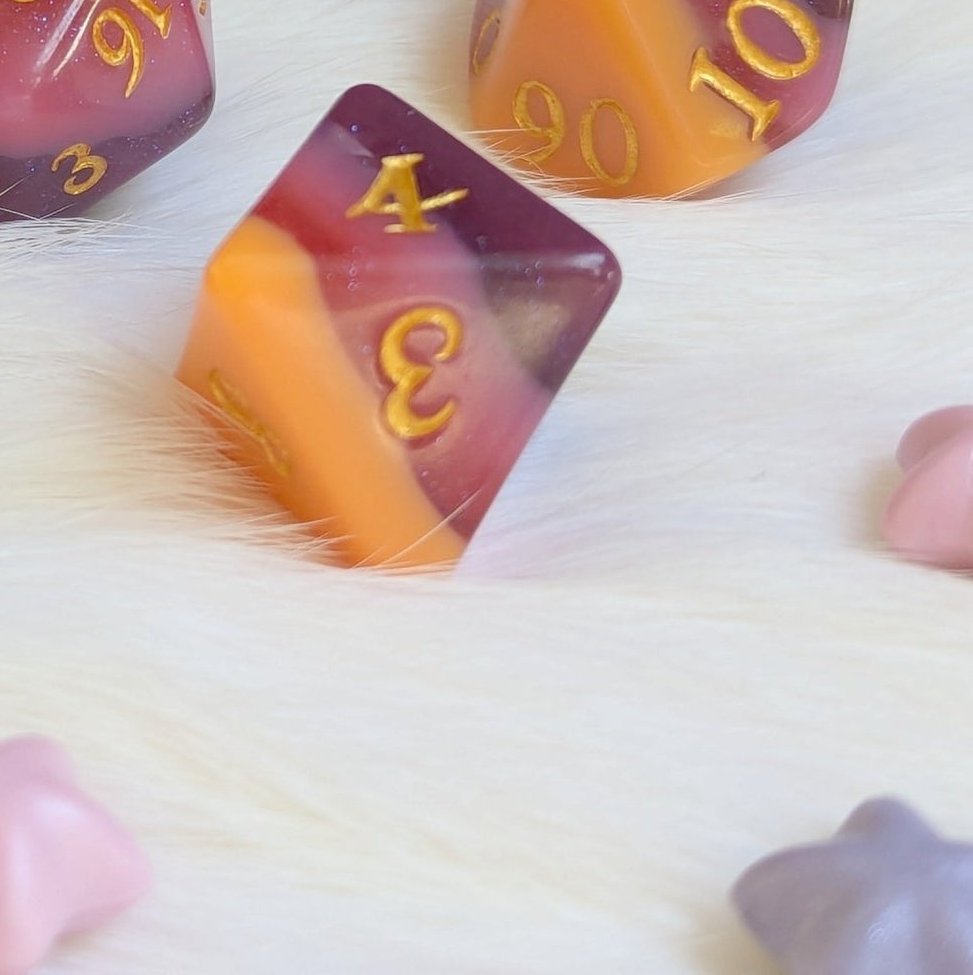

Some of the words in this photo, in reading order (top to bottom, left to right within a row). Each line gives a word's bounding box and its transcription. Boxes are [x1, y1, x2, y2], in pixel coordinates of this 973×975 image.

[52, 143, 108, 195] 3
[512, 80, 639, 186] 90
[346, 153, 469, 234] 4
[380, 307, 462, 437] 3
